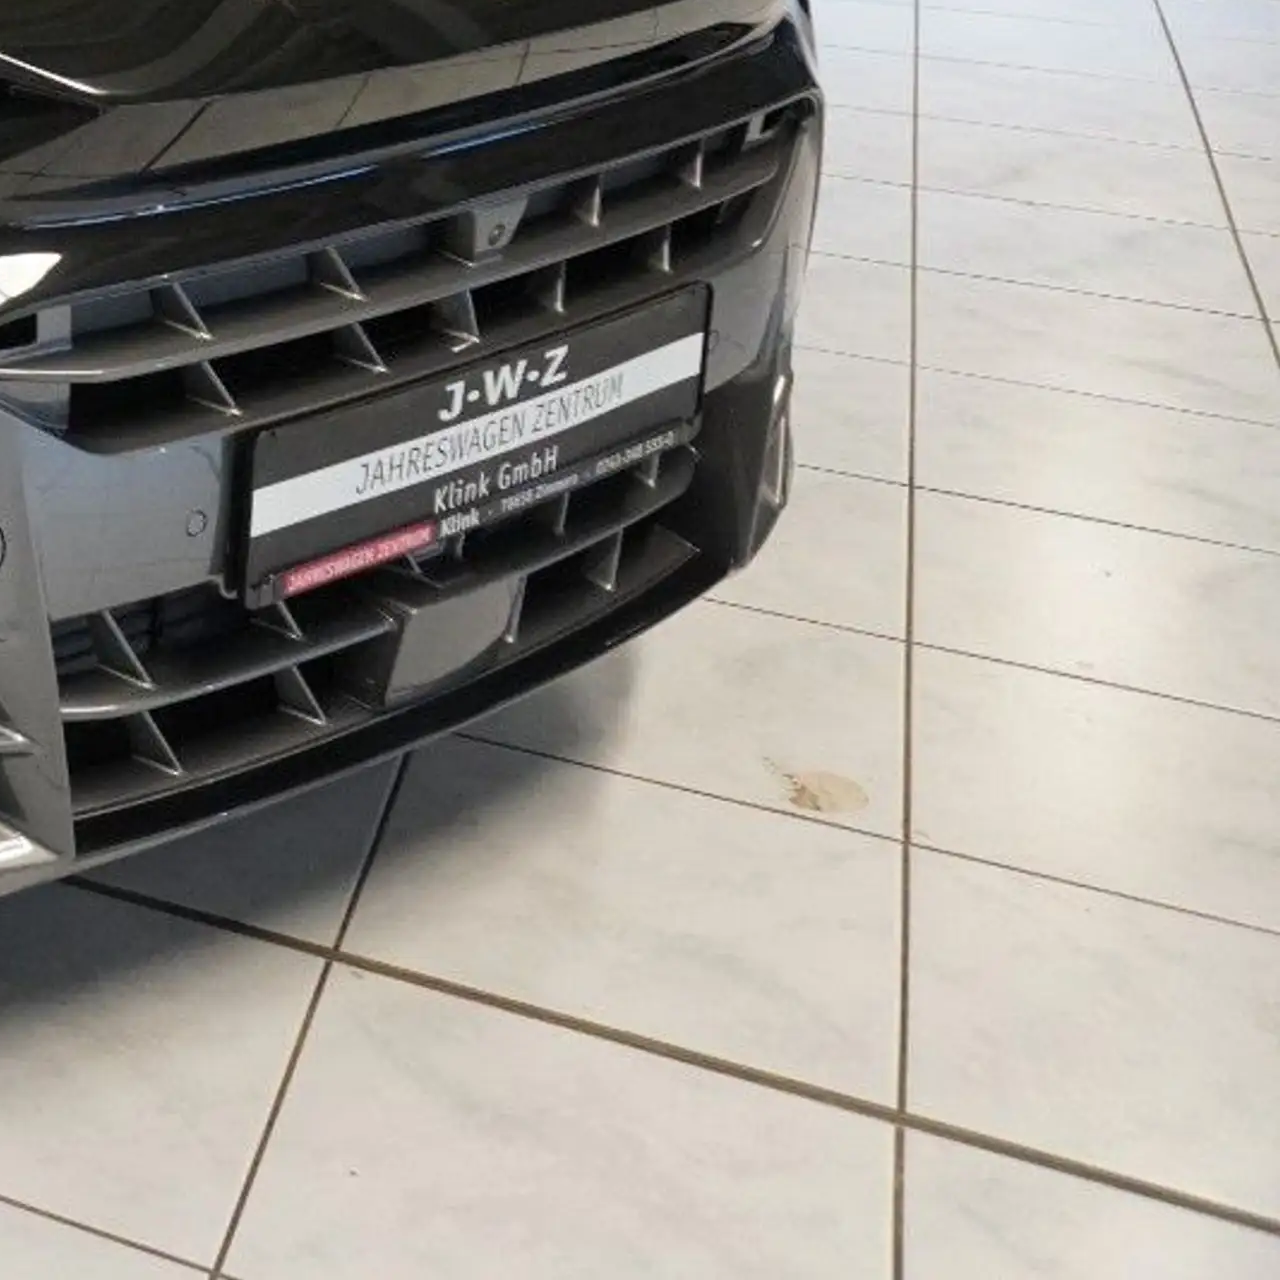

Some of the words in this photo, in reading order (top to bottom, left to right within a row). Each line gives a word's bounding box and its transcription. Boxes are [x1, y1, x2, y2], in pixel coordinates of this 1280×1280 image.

[355, 409, 527, 495] JAHRESWAGEN
[531, 371, 625, 433] ZENTRUM
[433, 471, 490, 515] Klink
[496, 444, 560, 491] GmbH
